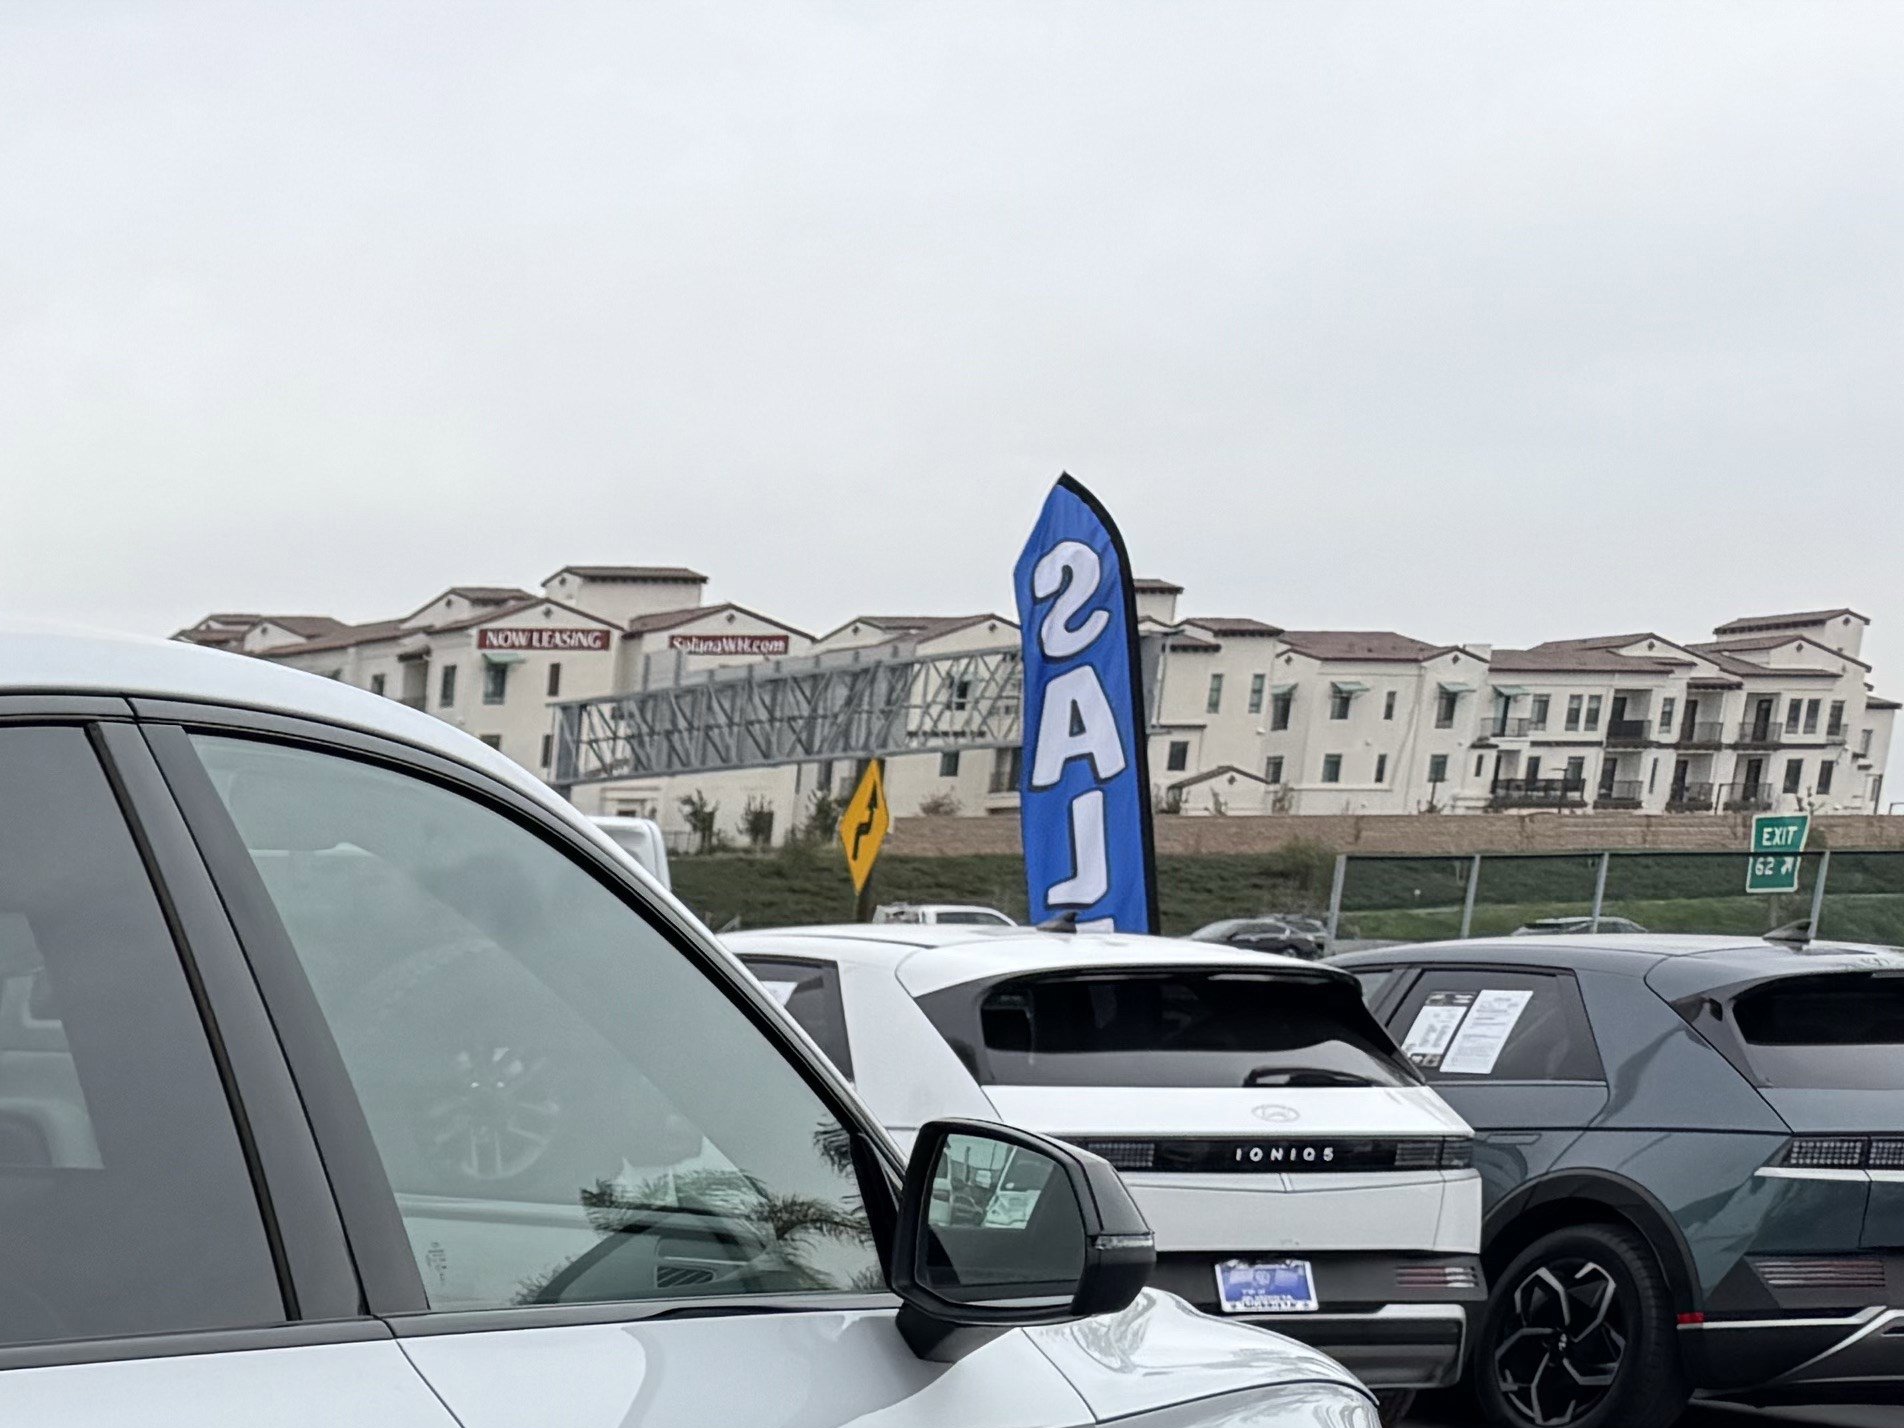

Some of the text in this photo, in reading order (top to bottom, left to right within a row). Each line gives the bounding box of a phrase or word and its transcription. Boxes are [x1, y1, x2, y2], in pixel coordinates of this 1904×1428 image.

[485, 630, 602, 648] NOW LEASING
[1762, 826, 1798, 846] EXIT
[1755, 856, 1775, 875] 62
